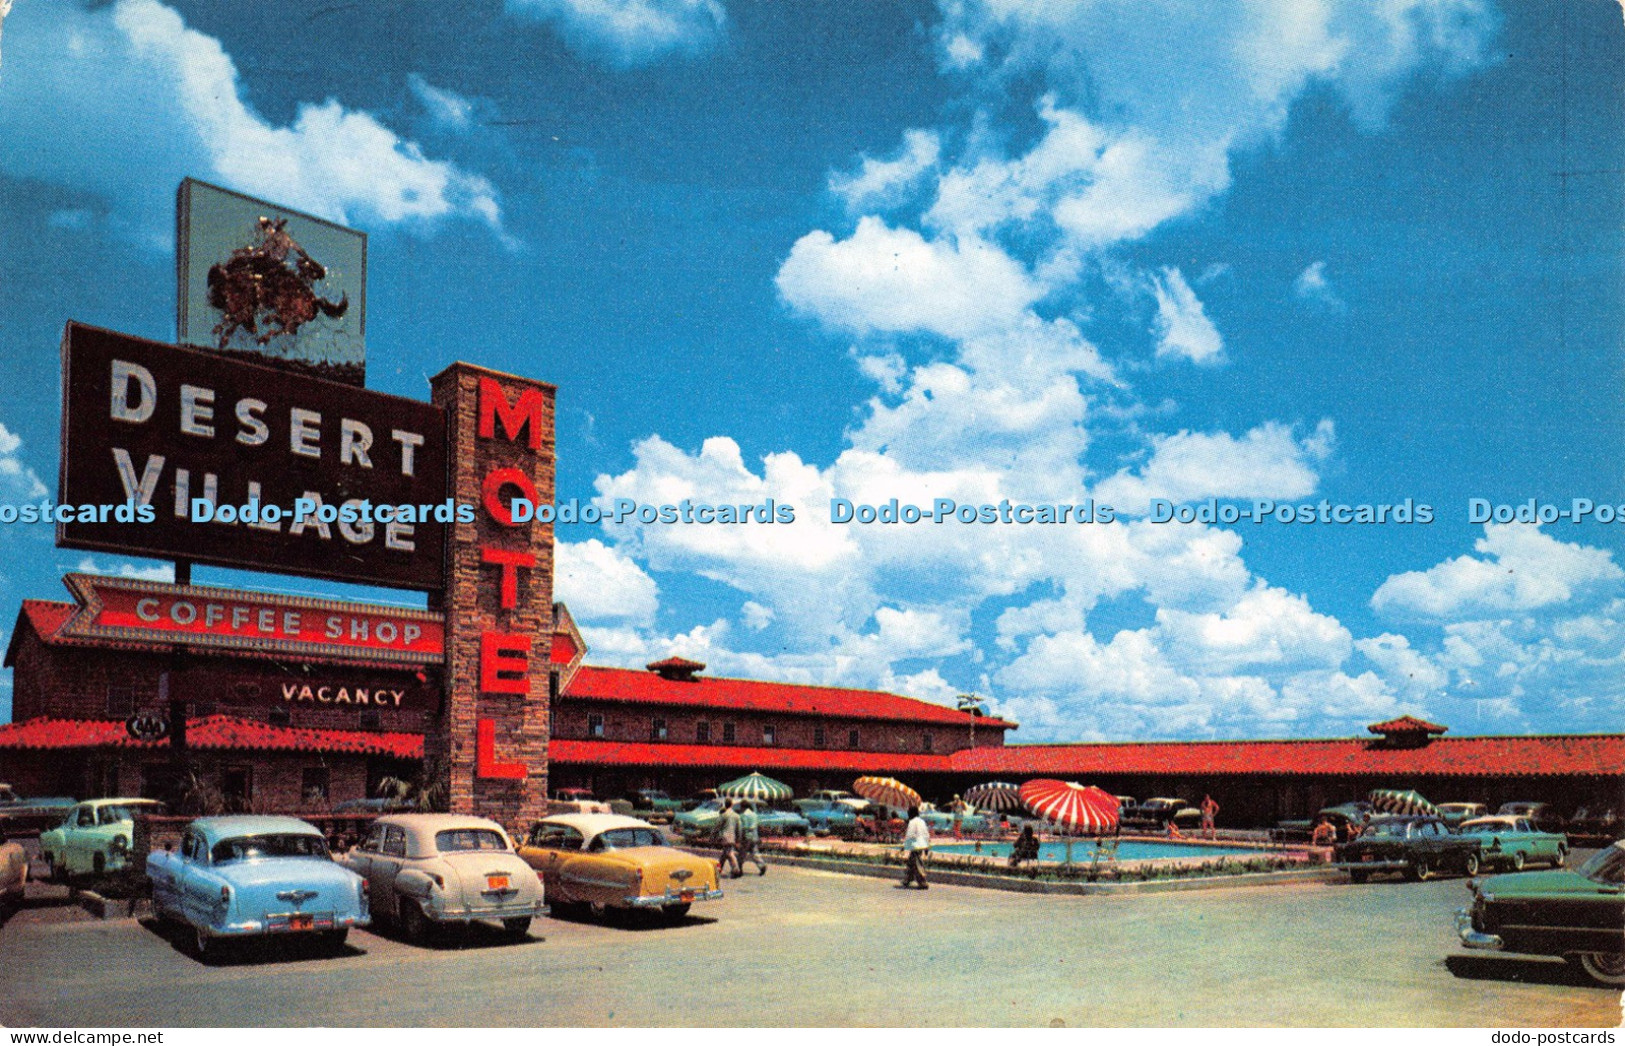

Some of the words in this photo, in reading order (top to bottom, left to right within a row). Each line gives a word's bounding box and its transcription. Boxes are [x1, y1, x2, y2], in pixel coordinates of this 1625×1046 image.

[110, 359, 425, 476] DESERT
[111, 447, 416, 551] VILLAGE
[136, 598, 301, 634] COFFEE
[325, 616, 421, 645] SHOP
[477, 376, 543, 779] MOTEL
[282, 683, 404, 706] VACANCY
